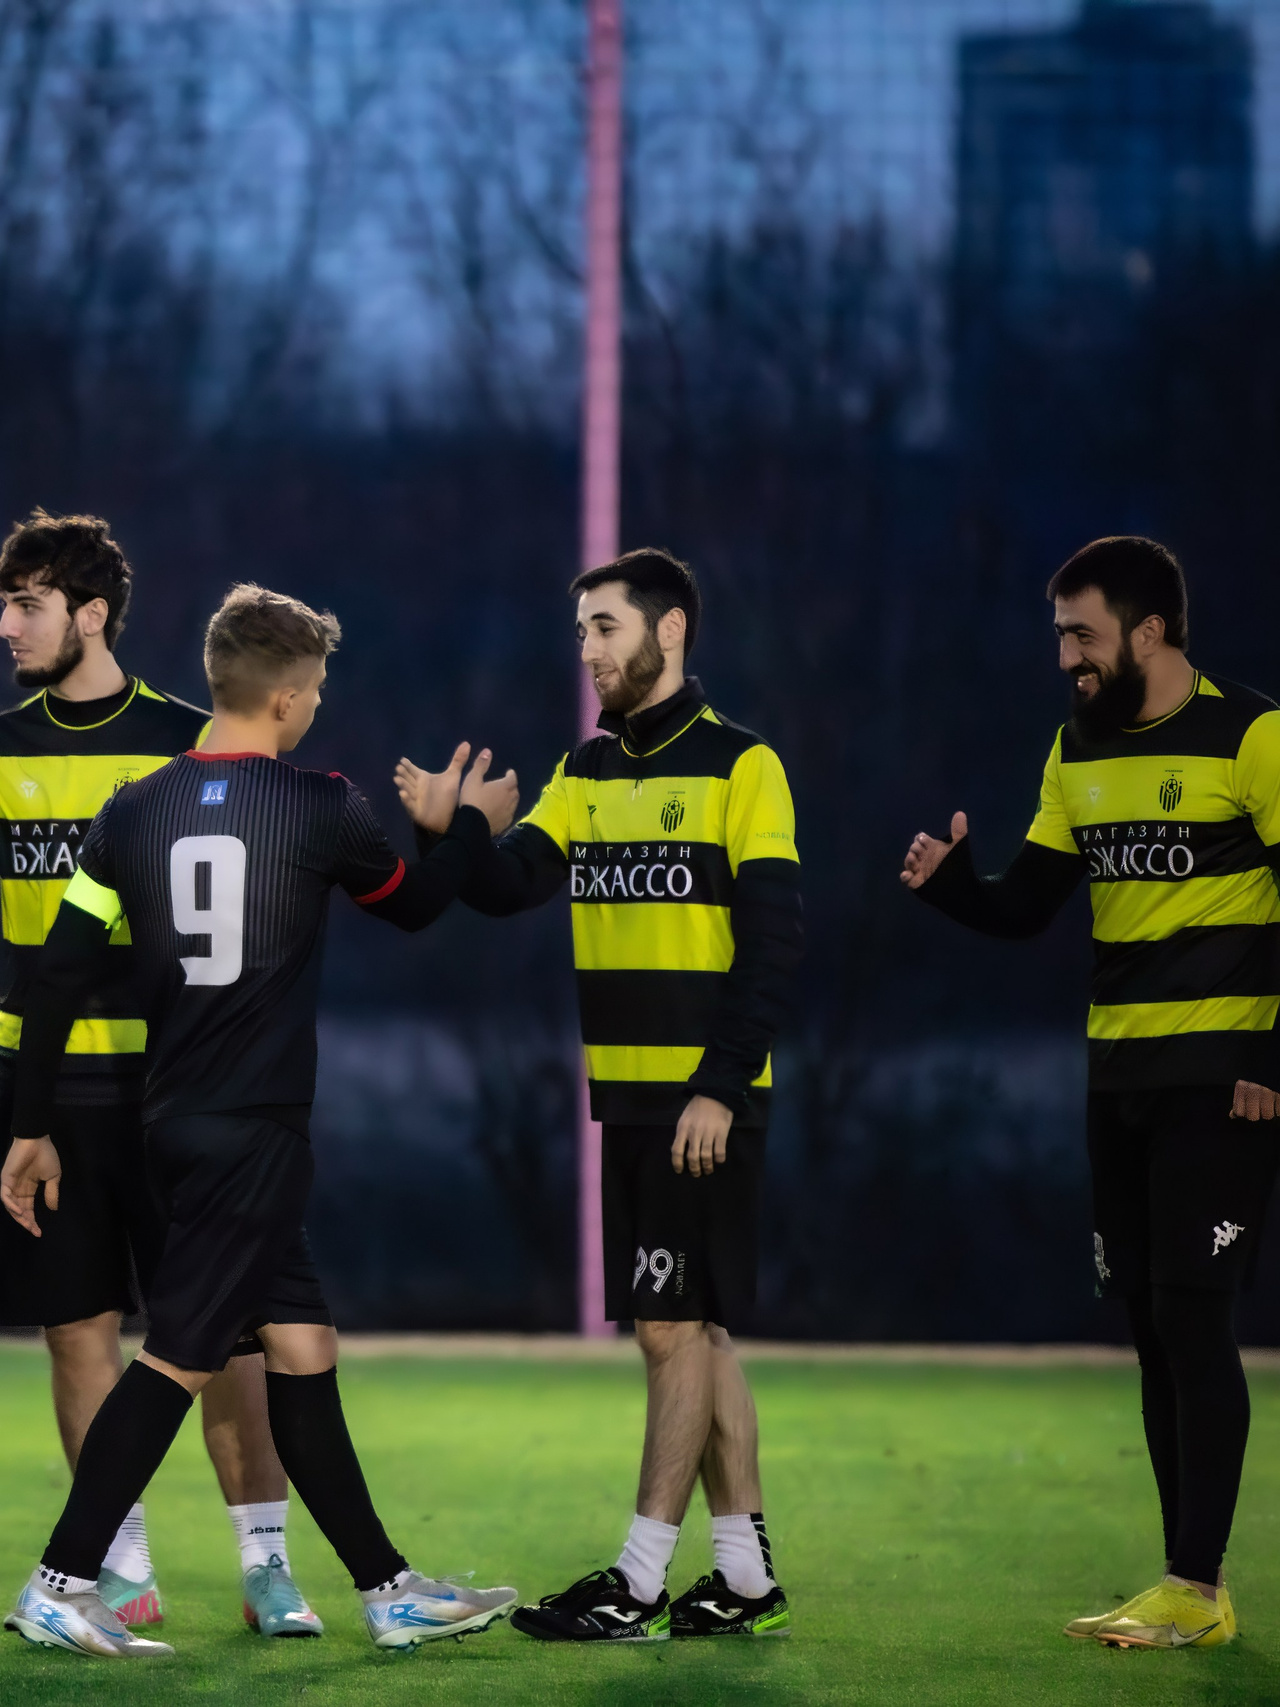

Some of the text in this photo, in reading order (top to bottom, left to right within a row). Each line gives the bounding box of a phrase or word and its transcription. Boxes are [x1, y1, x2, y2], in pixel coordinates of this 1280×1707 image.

[10, 823, 80, 837] МАГА
[10, 841, 83, 875] БЖА
[575, 845, 691, 859] МГАЗИН
[570, 863, 693, 898] БЖАССО
[170, 835, 247, 986] 9
